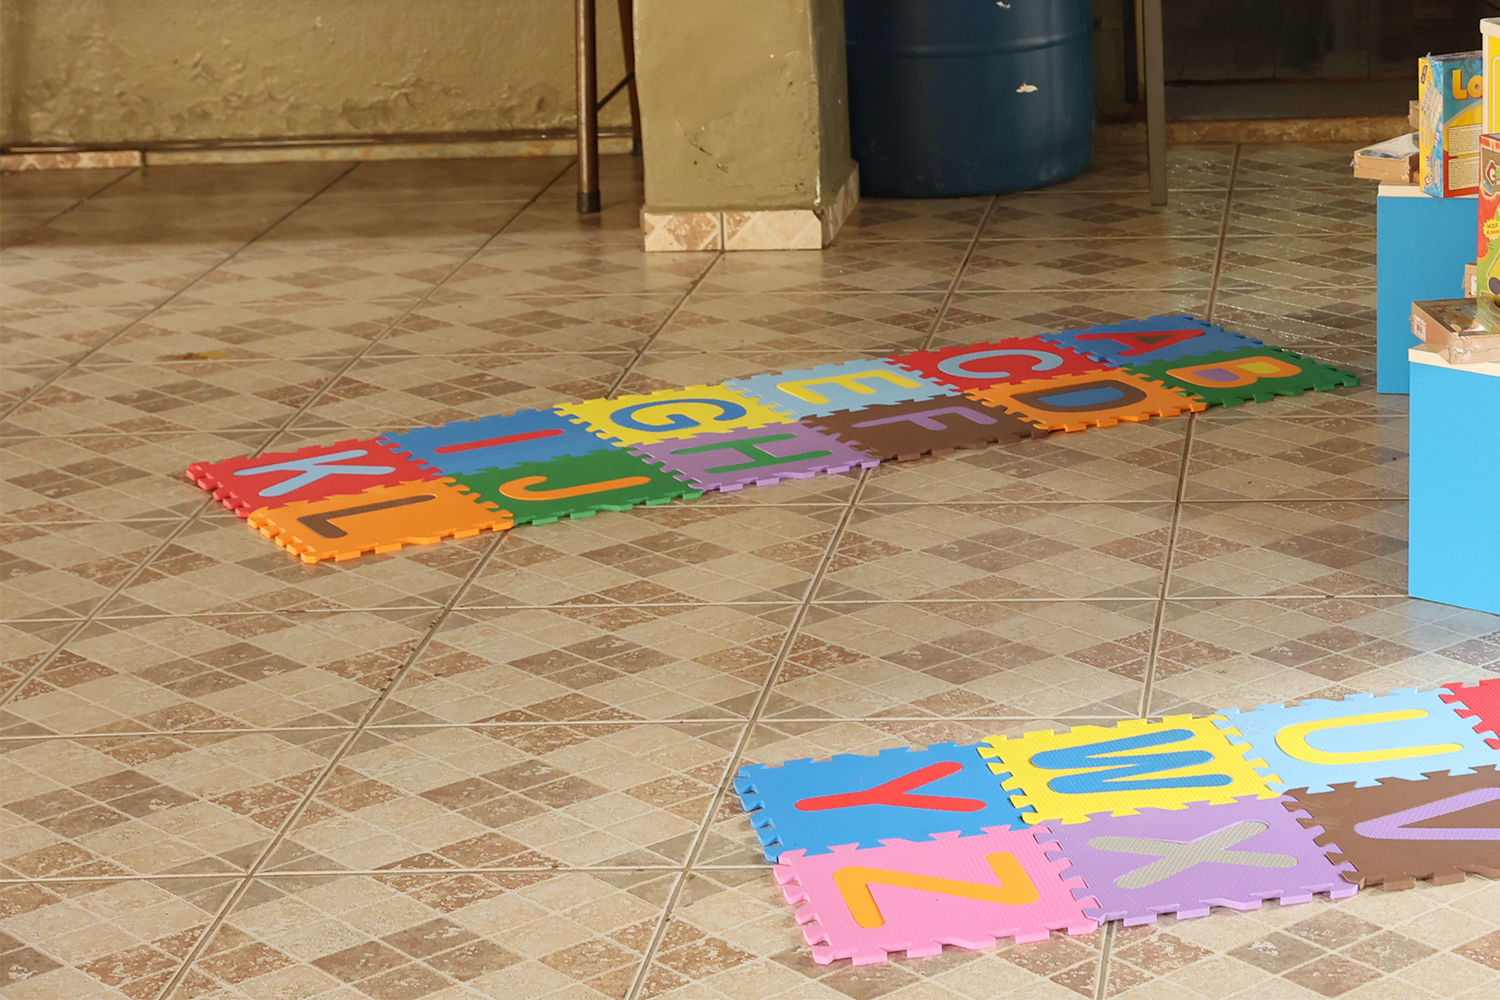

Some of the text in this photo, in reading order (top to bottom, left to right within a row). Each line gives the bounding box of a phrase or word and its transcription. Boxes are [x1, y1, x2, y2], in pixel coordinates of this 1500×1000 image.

[1074, 329, 1205, 356] A
[937, 348, 1064, 379] C
[1166, 355, 1302, 388] B
[776, 370, 922, 404] E
[1009, 380, 1148, 413] D
[609, 398, 747, 432] G
[851, 406, 999, 432] F
[434, 428, 565, 454] I
[670, 433, 833, 474] H
[233, 449, 396, 497] K
[498, 475, 651, 501] J
[297, 493, 437, 539] L
[1275, 709, 1464, 766] U
[1030, 728, 1233, 795] W
[795, 761, 987, 813] Y
[1088, 820, 1298, 889] X
[831, 851, 1040, 929] Z
